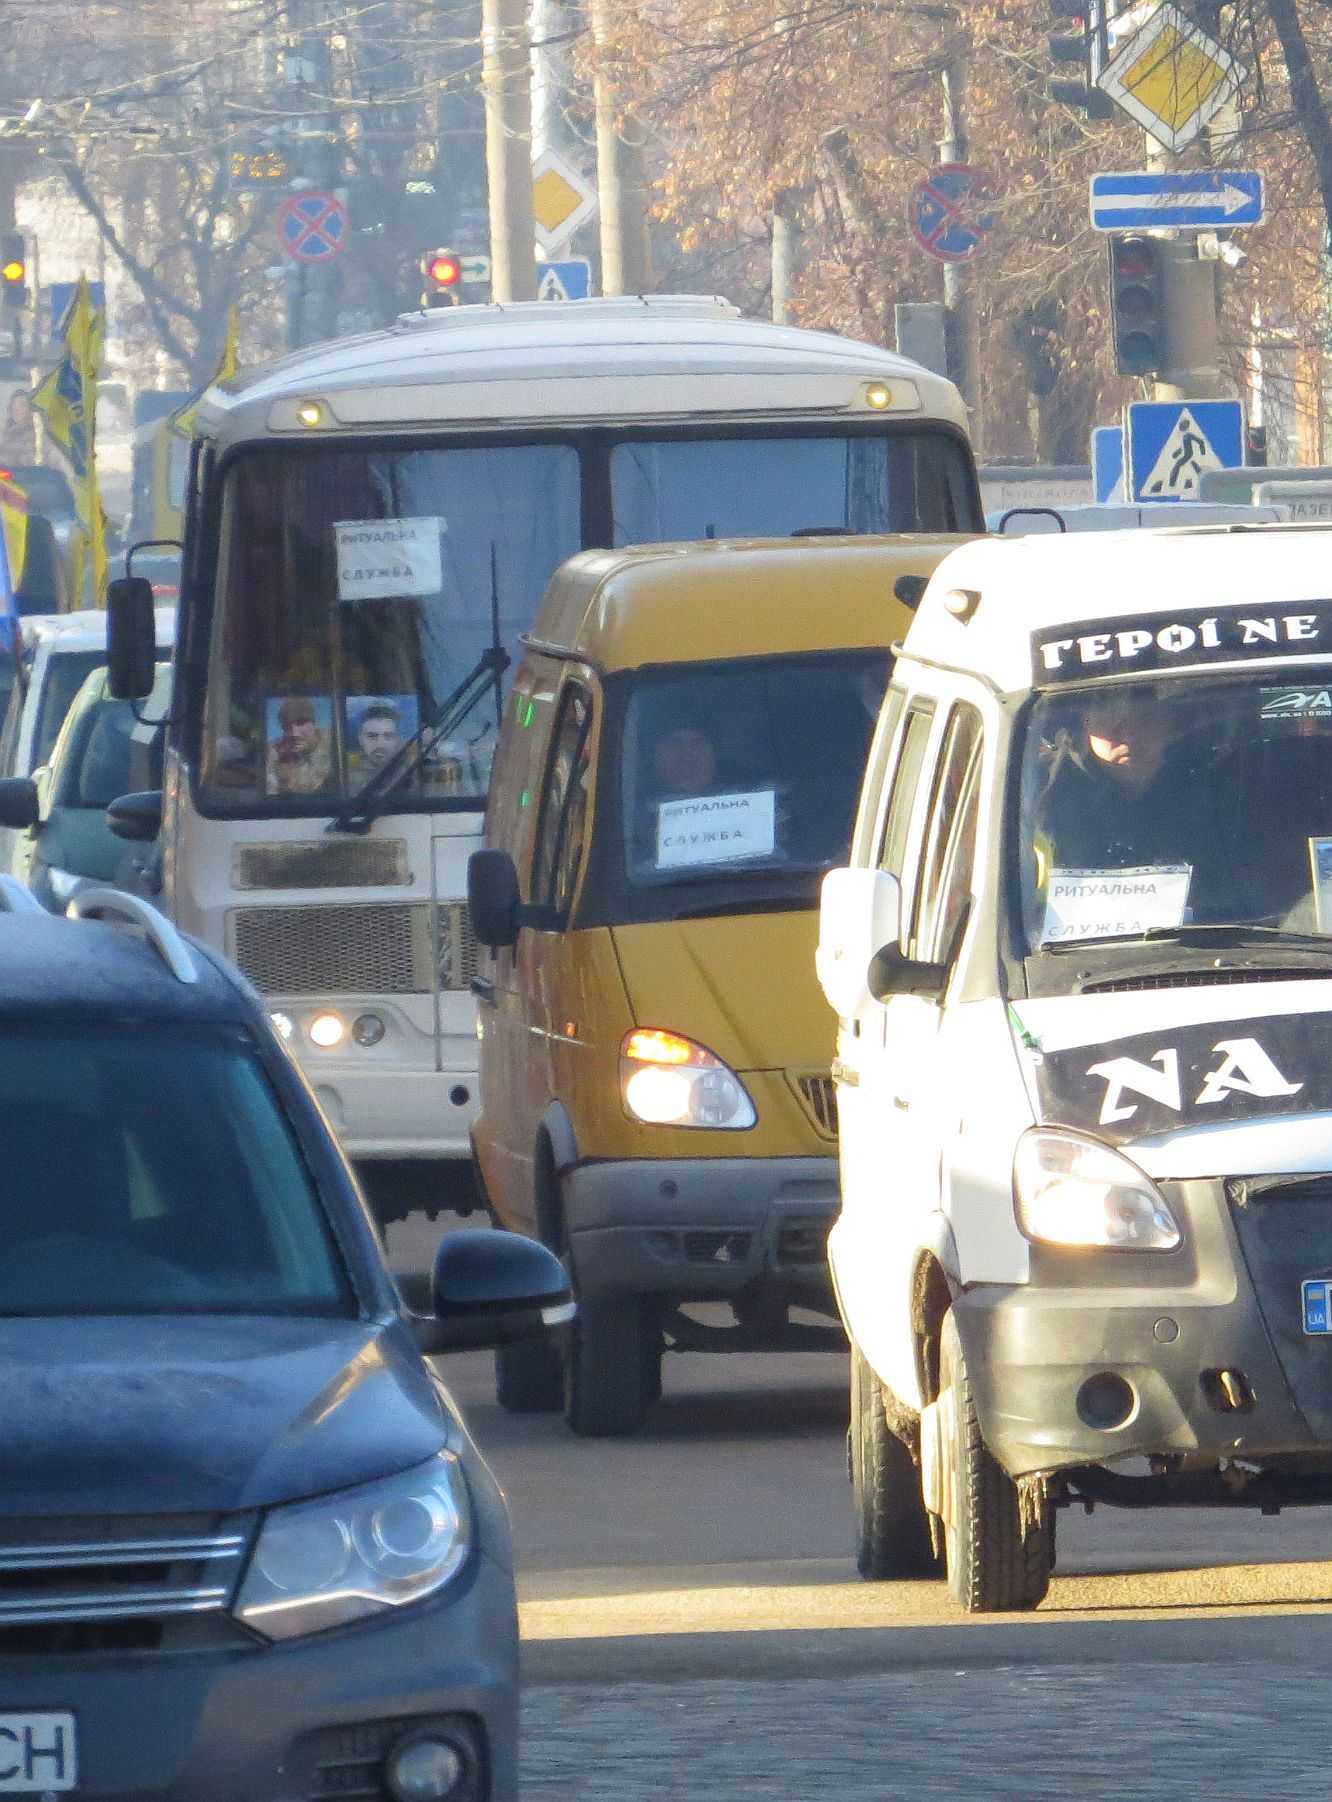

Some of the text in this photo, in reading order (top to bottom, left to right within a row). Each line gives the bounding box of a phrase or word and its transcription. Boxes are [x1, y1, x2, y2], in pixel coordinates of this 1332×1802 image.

[1040, 617, 1223, 669] ГЕРОЇ
[663, 799, 750, 817] РИТУАЛЬНА
[663, 829, 742, 848] СЛУЖБА
[1054, 883, 1157, 897] РИТУАЛЬНА
[1048, 921, 1143, 937] СЛУЖБА
[0, 1726, 65, 1780] CH
